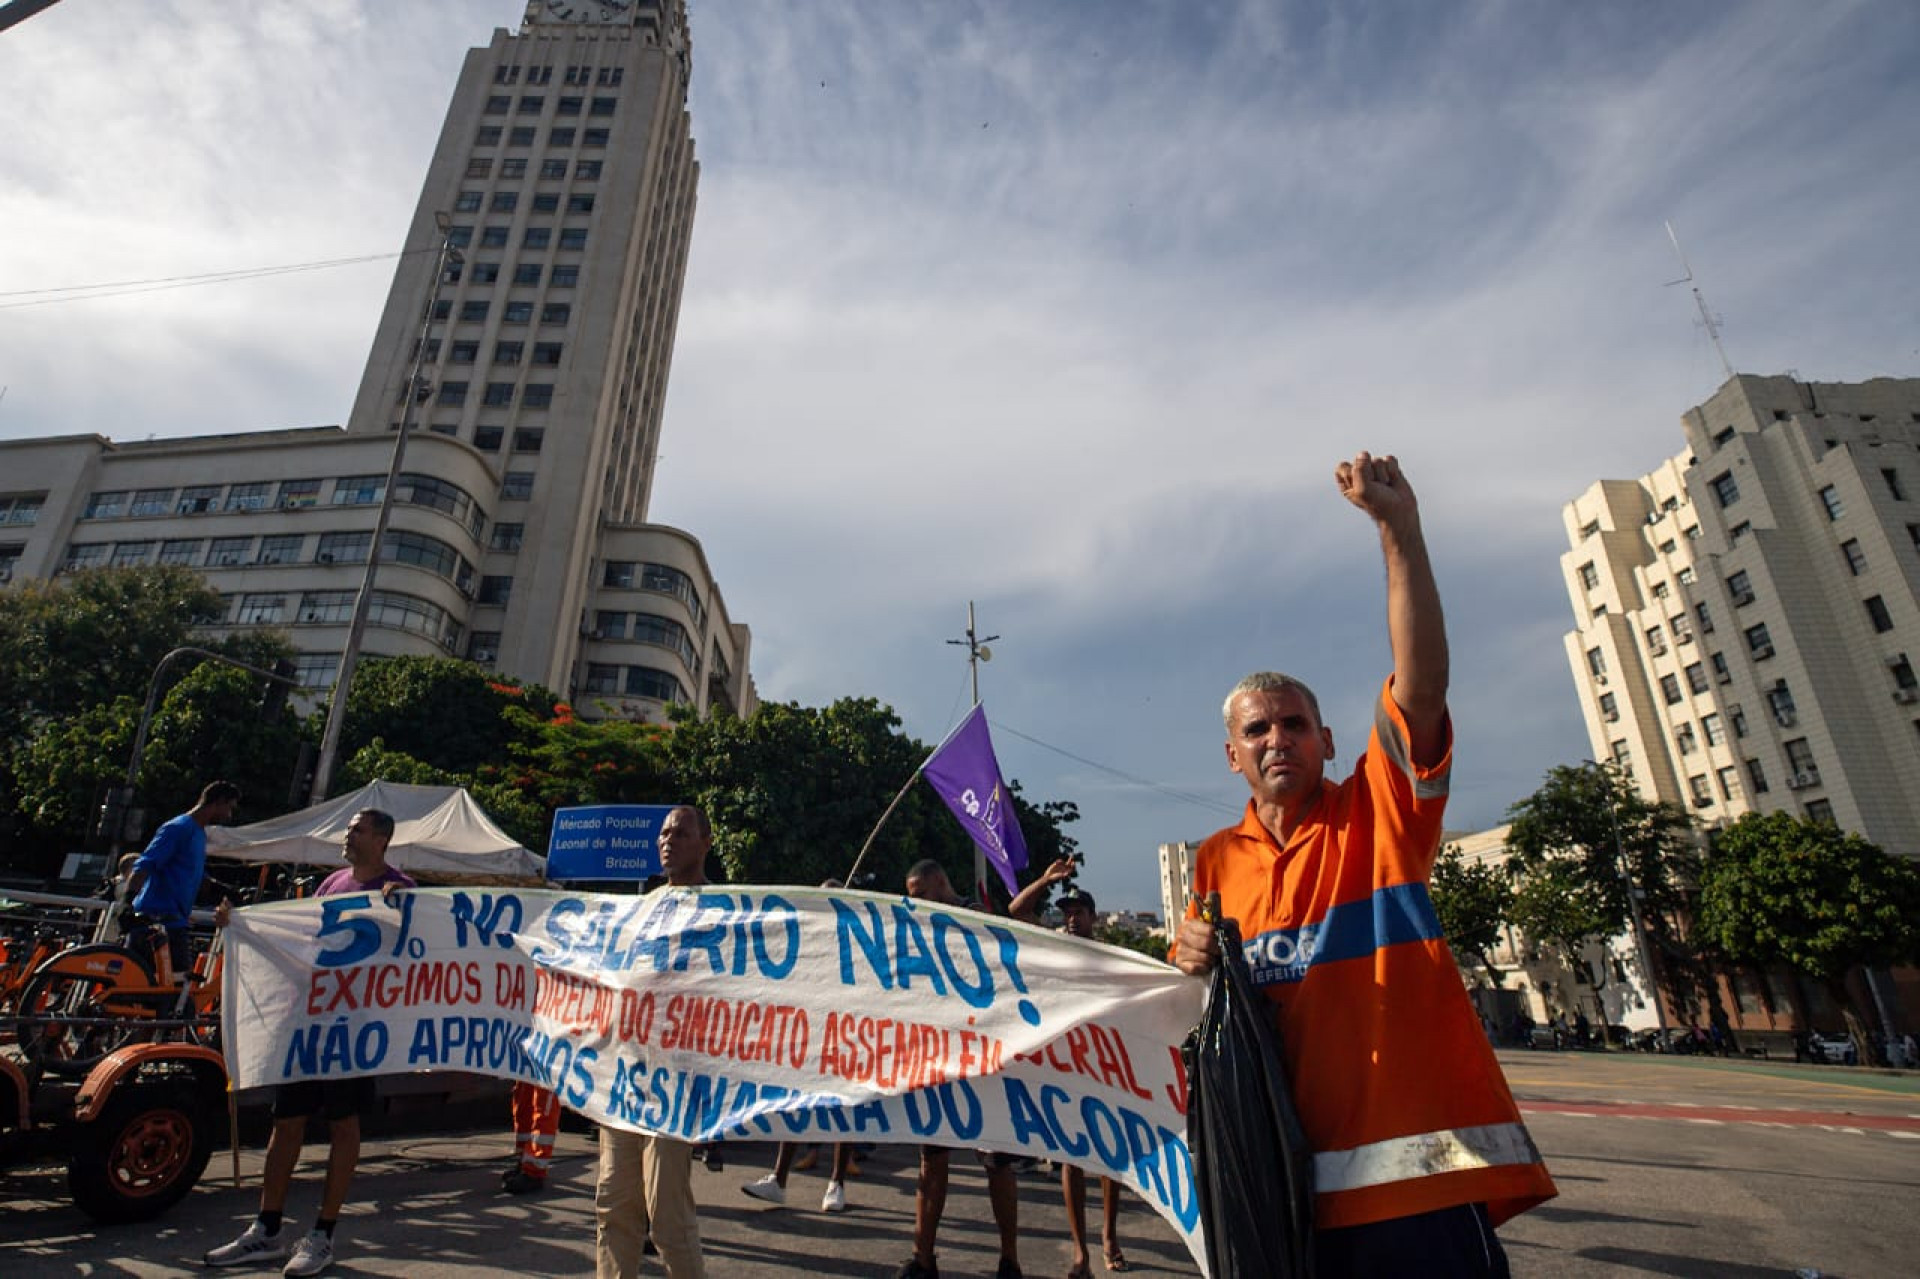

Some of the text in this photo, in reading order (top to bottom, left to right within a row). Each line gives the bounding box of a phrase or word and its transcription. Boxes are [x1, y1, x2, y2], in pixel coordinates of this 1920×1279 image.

[556, 836, 649, 850] Leonel de Moura
[560, 816, 650, 831] Mercado Popular
[605, 857, 647, 869] Brizola
[315, 893, 425, 967] 5%
[451, 891, 522, 948] NO
[828, 896, 1041, 1027] NÃO!
[307, 961, 482, 1015] EXIGIMOS
[495, 962, 526, 1012] DA
[618, 988, 655, 1045] DO
[661, 995, 809, 1069] SINDICATO
[283, 1016, 389, 1078] NÃO
[903, 1078, 983, 1139] DO
[1002, 1076, 1200, 1235] ACORD
